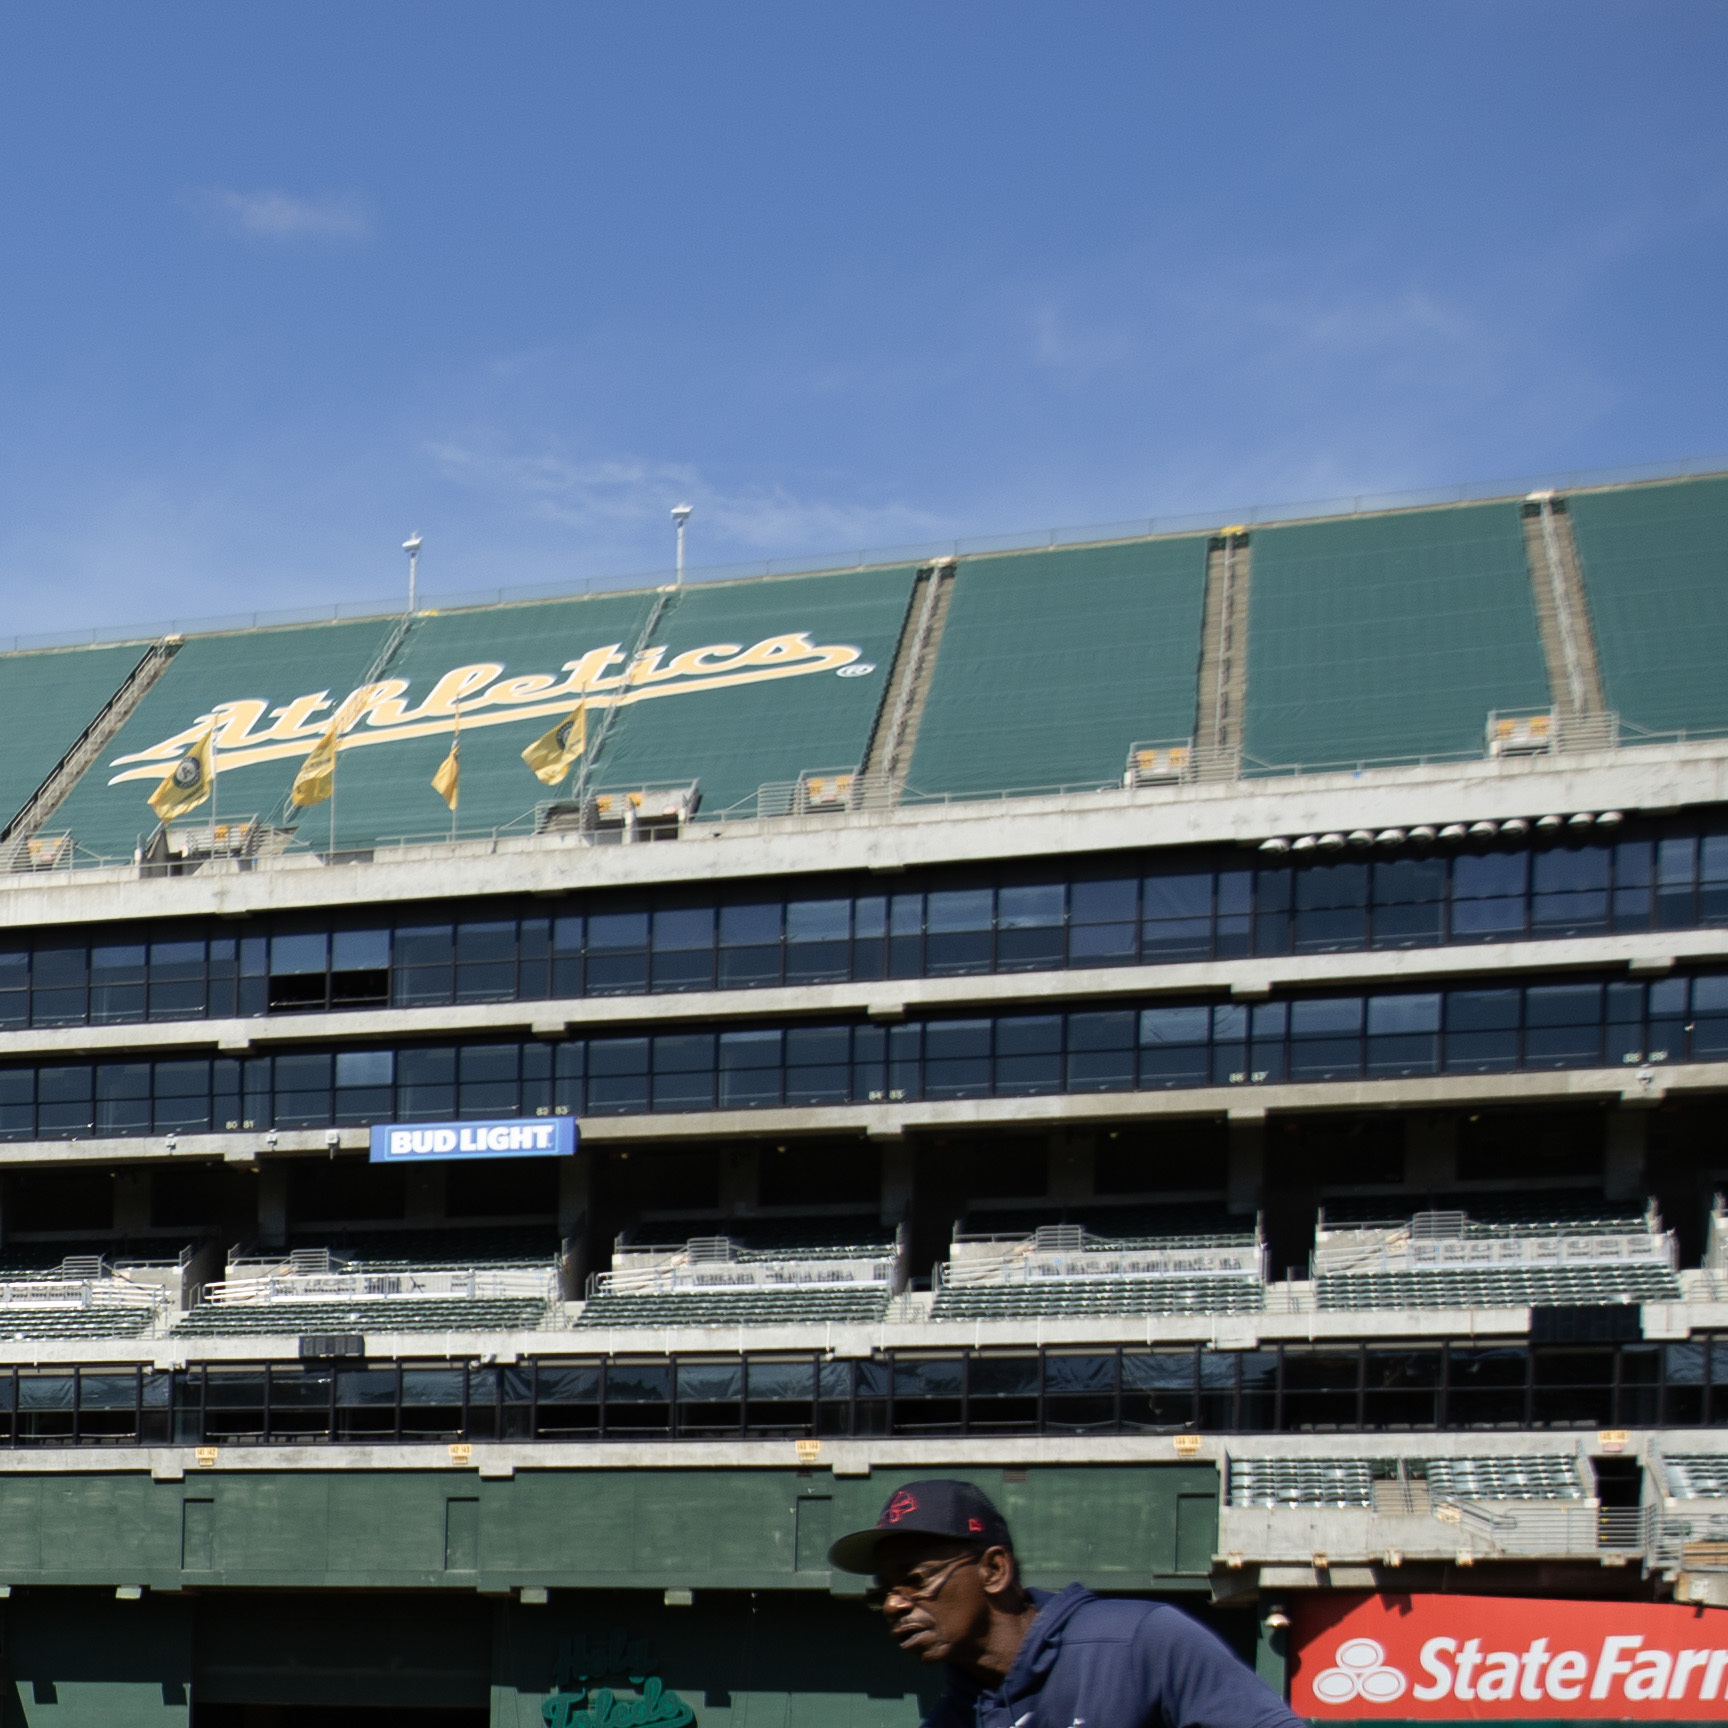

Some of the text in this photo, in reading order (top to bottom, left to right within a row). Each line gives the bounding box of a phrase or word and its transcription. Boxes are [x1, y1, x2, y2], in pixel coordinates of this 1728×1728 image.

[108, 633, 862, 786] Athletics
[390, 1125, 553, 1155] BUD LIGHT
